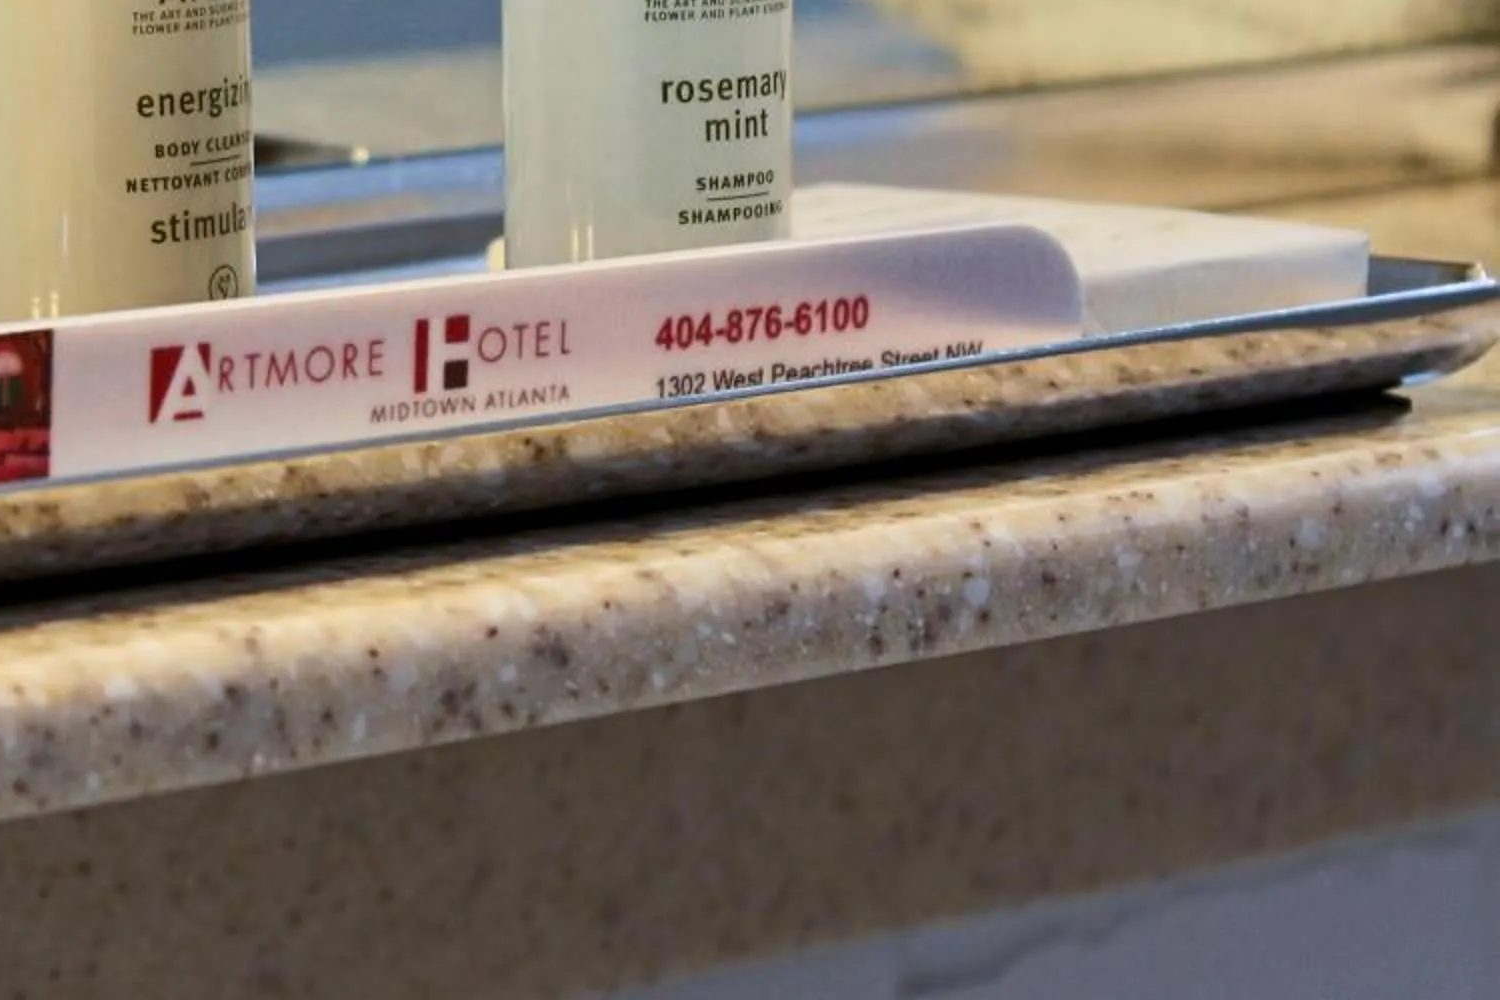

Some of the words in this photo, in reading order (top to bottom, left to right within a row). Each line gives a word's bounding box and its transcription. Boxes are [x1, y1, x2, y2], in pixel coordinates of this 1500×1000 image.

[132, 10, 155, 22] THE
[159, 8, 182, 20] ART
[185, 6, 207, 18] AND
[645, 10, 695, 22] FLOWER
[701, 8, 725, 20] AND
[660, 69, 787, 105] rosemary
[705, 108, 769, 143] mint
[154, 139, 200, 159] BODY
[125, 169, 220, 193] NETTOYANT
[695, 169, 775, 191] SHAMPOO
[151, 201, 252, 245] stimula
[677, 199, 783, 225] SHAMPOOING
[654, 295, 870, 350] 404-876-6100
[148, 338, 386, 424] ARTMORE
[413, 313, 571, 395] HOTEL
[656, 371, 706, 400] 1302
[713, 364, 765, 390] West
[771, 353, 875, 384] Peachtree
[881, 347, 940, 367] Street
[370, 395, 476, 424] MIDTOWN
[483, 383, 571, 411] ATLANTA
